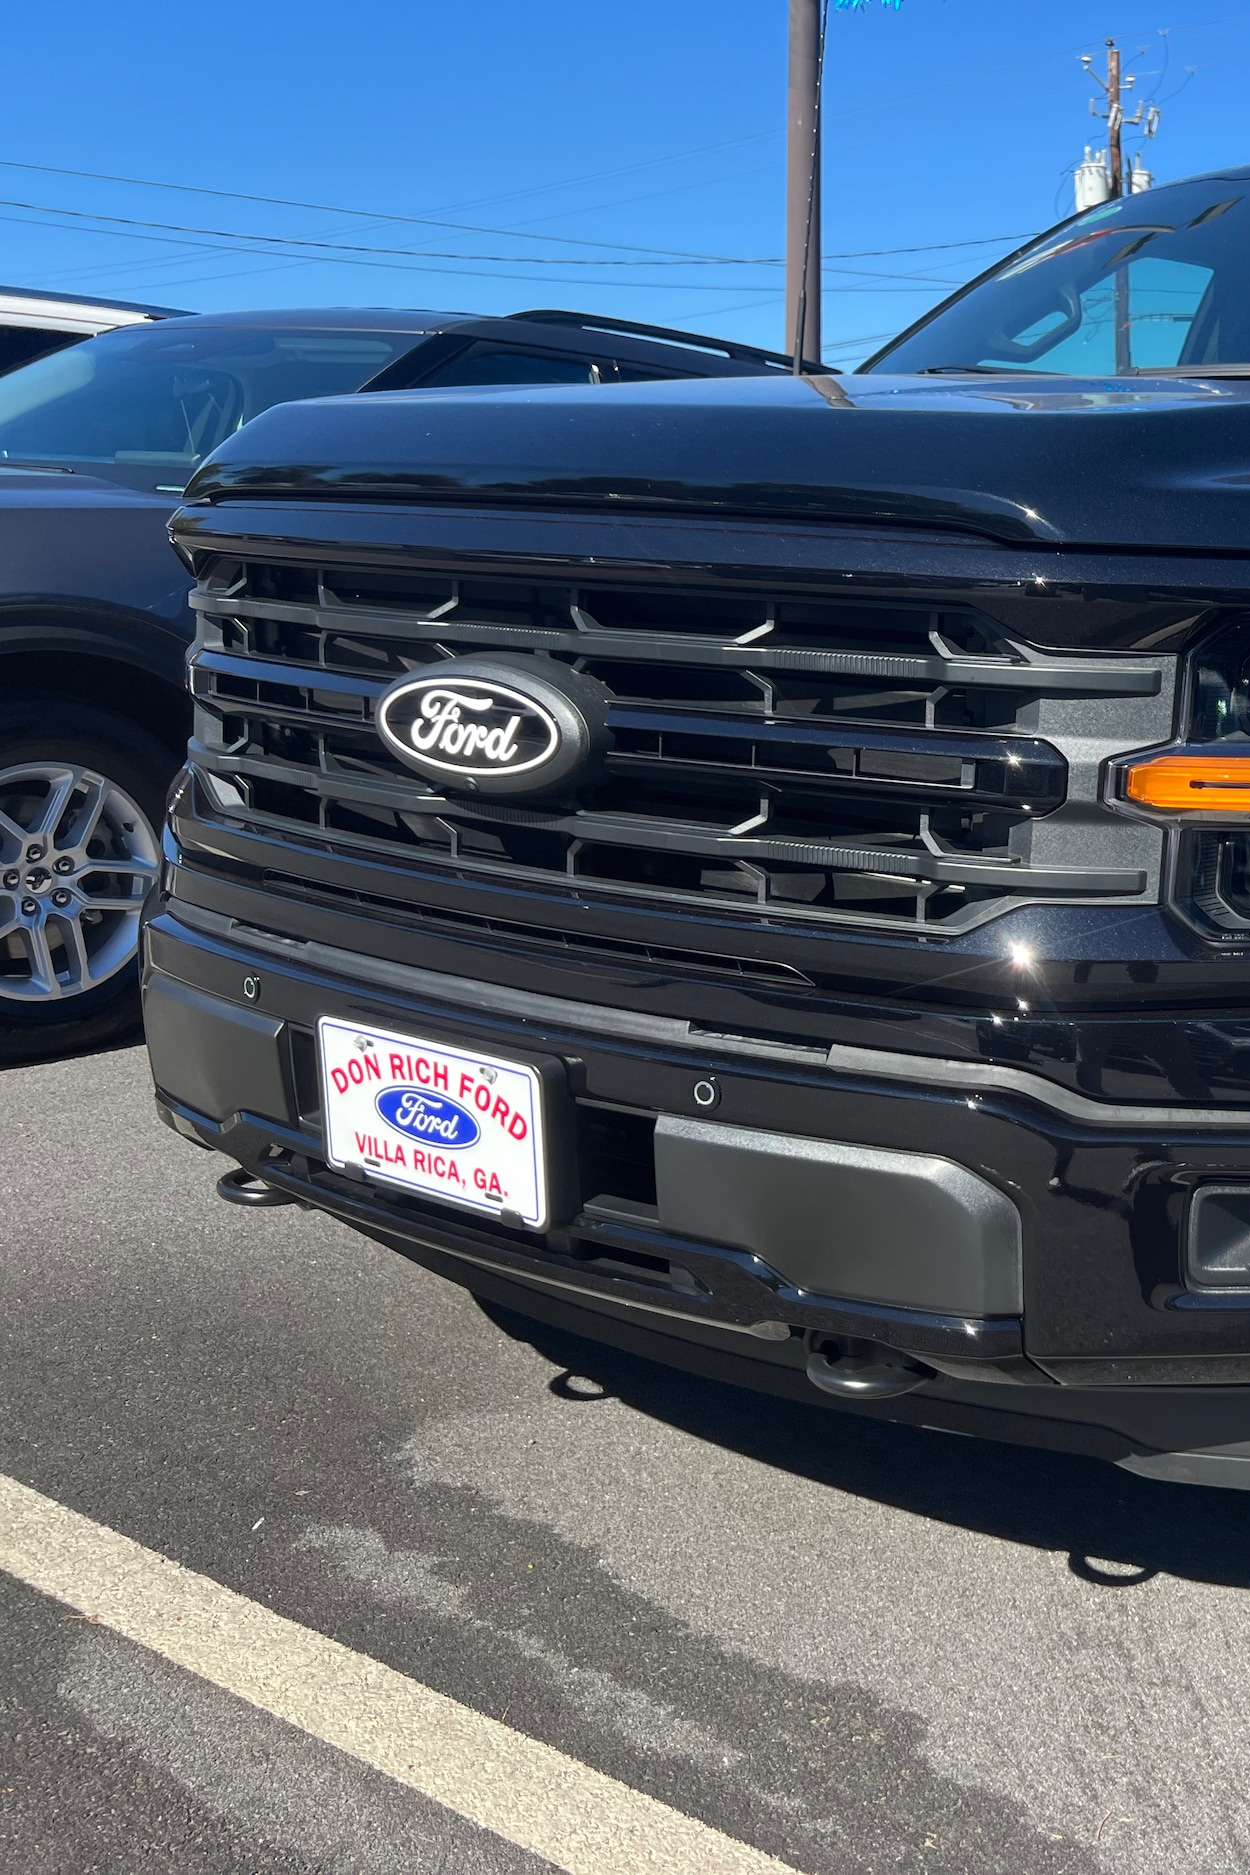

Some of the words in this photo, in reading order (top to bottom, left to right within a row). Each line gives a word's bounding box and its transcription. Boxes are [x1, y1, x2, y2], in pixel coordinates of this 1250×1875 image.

[411, 689, 521, 761] Ford
[330, 1053, 382, 1094] DON
[389, 1053, 448, 1091] RICH
[459, 1073, 527, 1141] FORD
[396, 1093, 459, 1139] Ford
[355, 1131, 407, 1167] VILLA
[413, 1149, 466, 1188] RICA,
[473, 1168, 509, 1197] GA.
